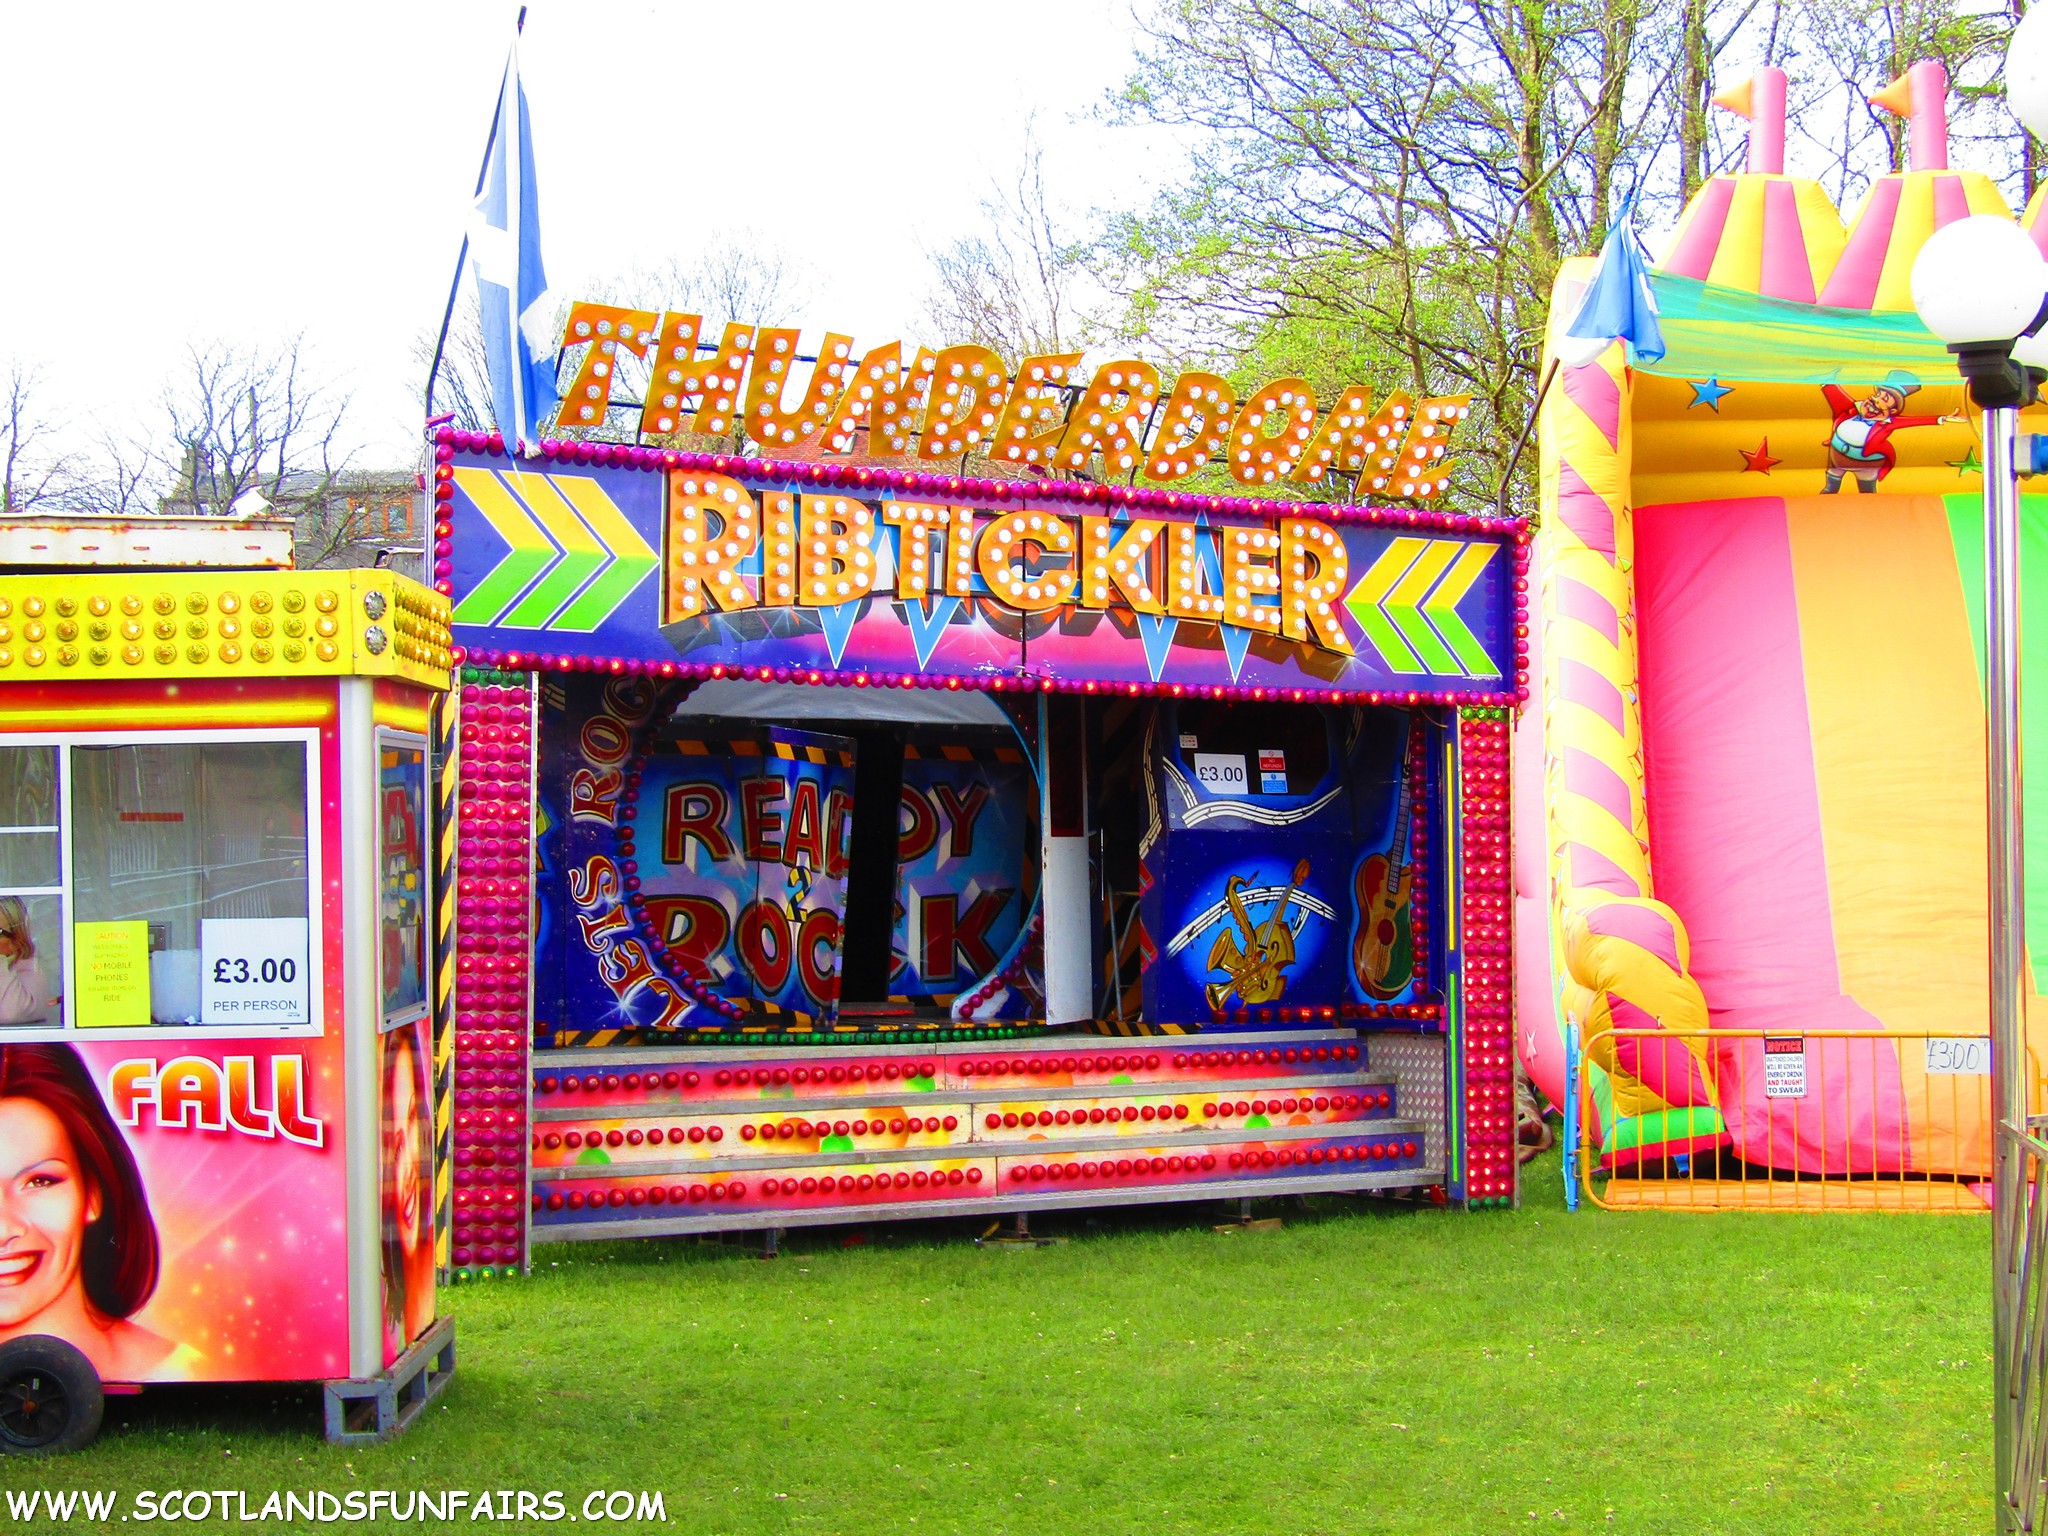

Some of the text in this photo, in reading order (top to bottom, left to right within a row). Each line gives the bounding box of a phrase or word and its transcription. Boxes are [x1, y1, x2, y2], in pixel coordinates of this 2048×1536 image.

[556, 301, 1473, 499] THUNDERDOME
[664, 468, 1355, 657] RIBTICKLER
[1199, 766, 1243, 782] £3.00
[90, 961, 133, 970] NO MOBILE
[213, 958, 296, 983] £3.00
[95, 974, 129, 982] PHONES
[104, 994, 121, 1002] RIDE
[213, 1000, 297, 1011] PER PERSON
[107, 1054, 325, 1149] FALL
